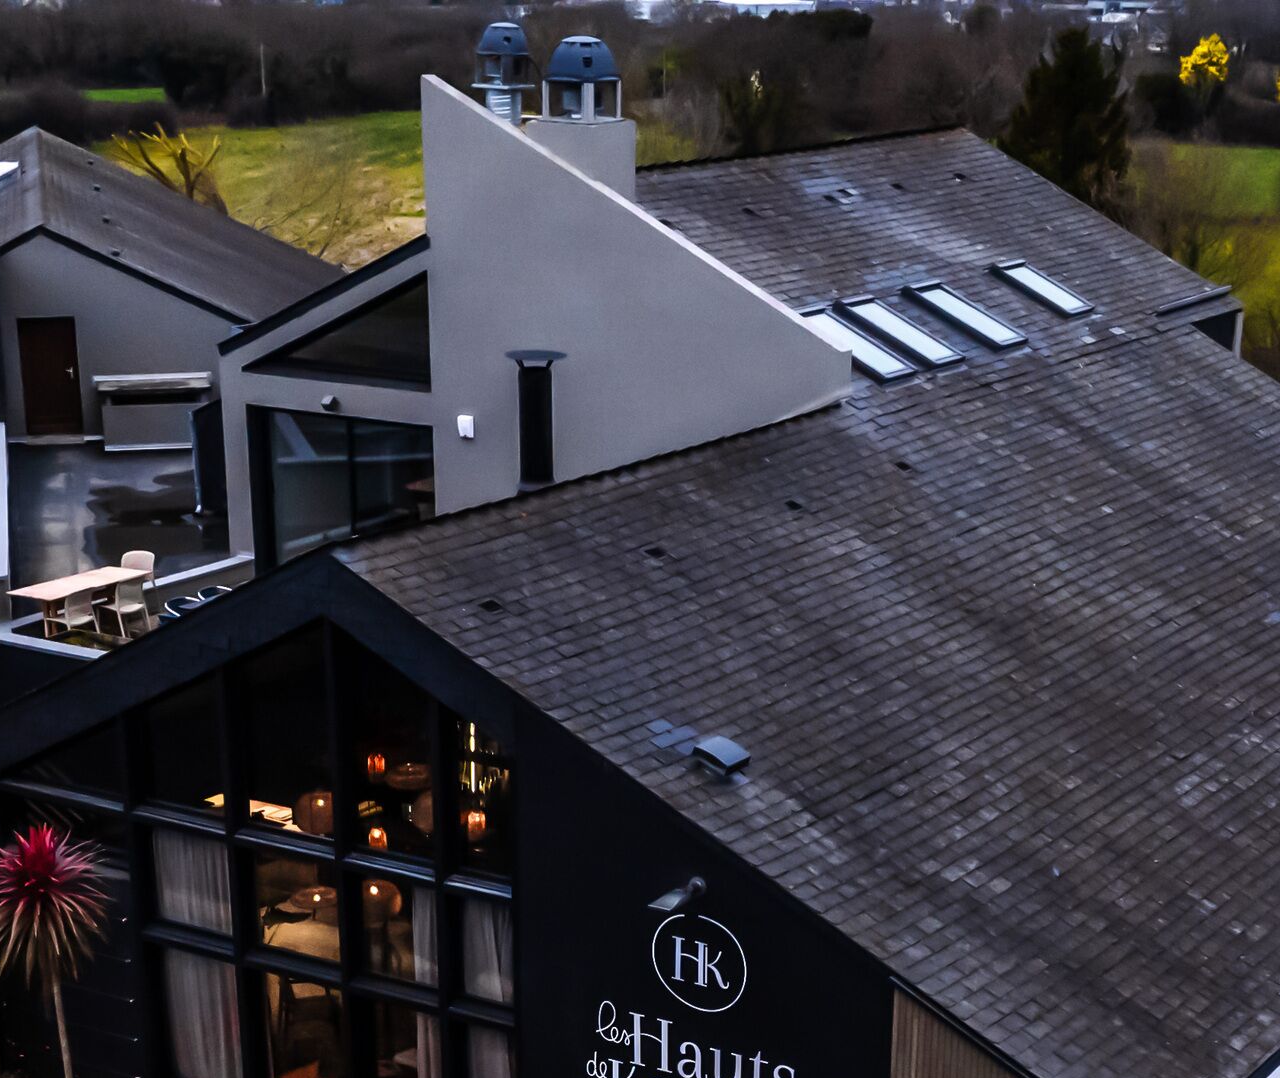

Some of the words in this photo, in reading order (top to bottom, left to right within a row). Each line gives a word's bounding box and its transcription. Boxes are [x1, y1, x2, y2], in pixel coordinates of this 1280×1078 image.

[671, 935, 730, 990] HK
[595, 1000, 631, 1046] les
[586, 1050, 609, 1078] de
